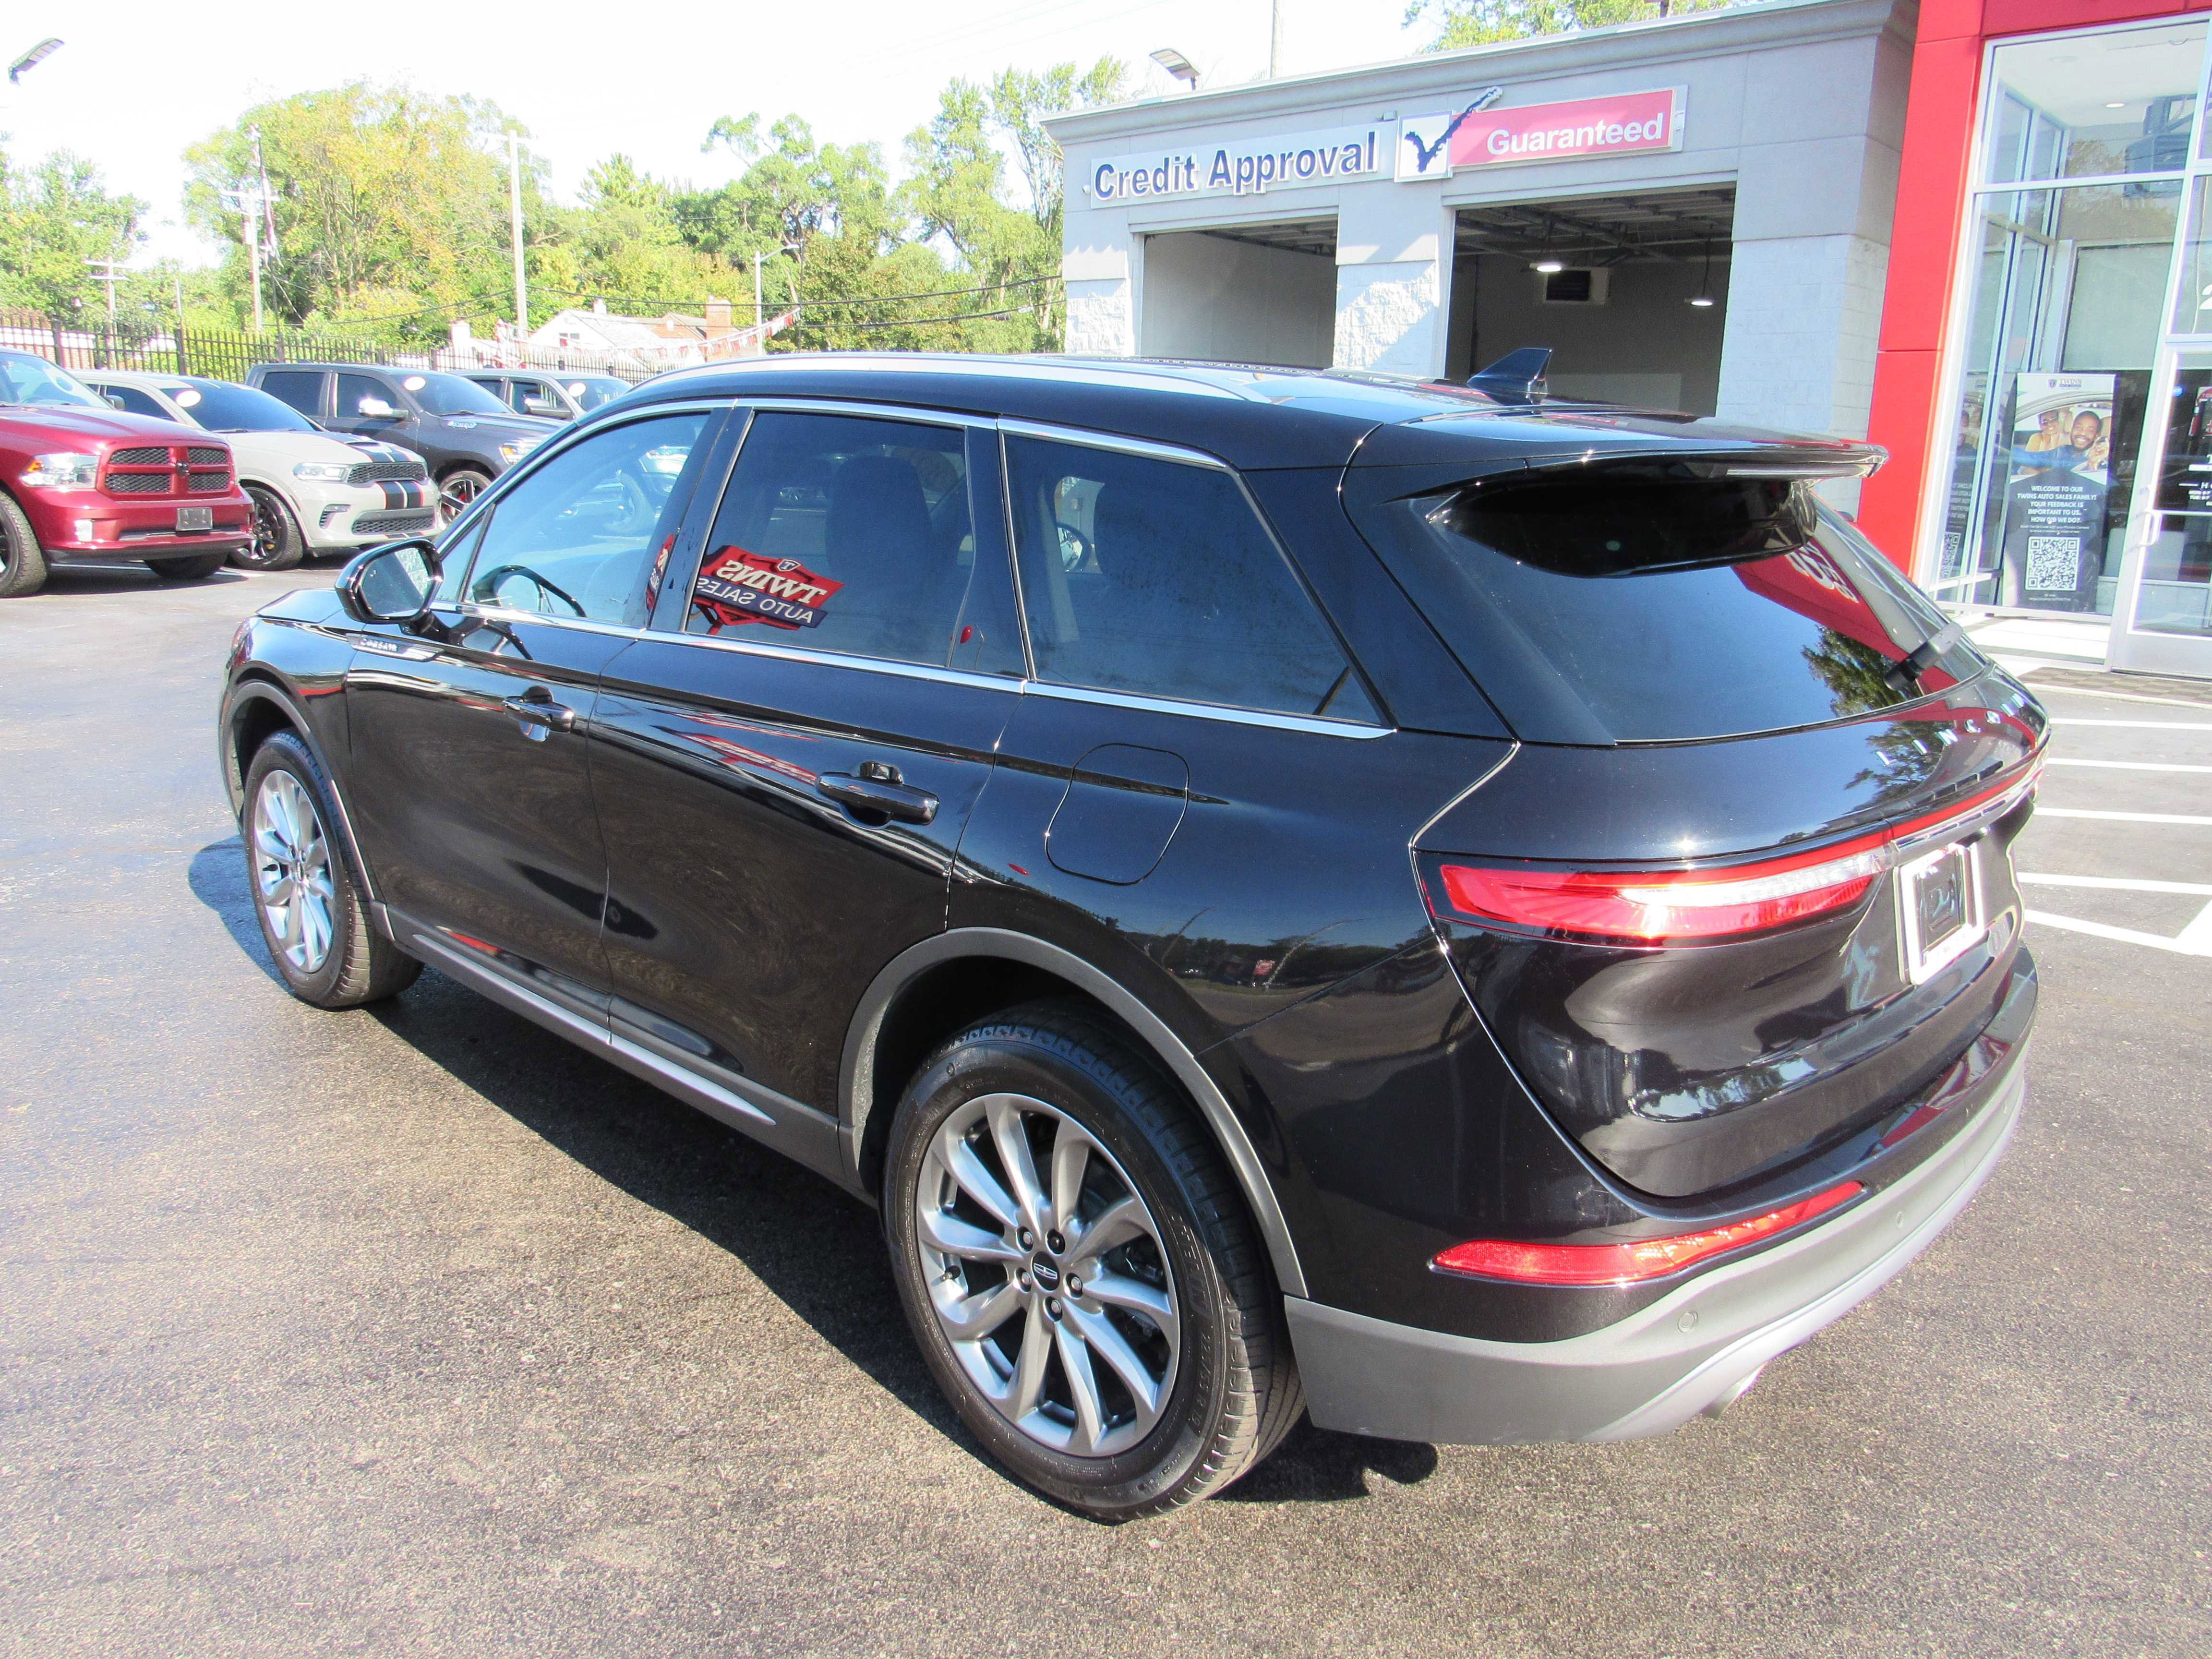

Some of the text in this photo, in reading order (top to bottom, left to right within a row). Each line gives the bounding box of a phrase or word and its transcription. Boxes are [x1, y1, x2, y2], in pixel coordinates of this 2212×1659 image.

[1487, 113, 1664, 155] Guaranteed
[1094, 131, 1380, 201] Credit Approval
[360, 637, 398, 652] CORSAIR
